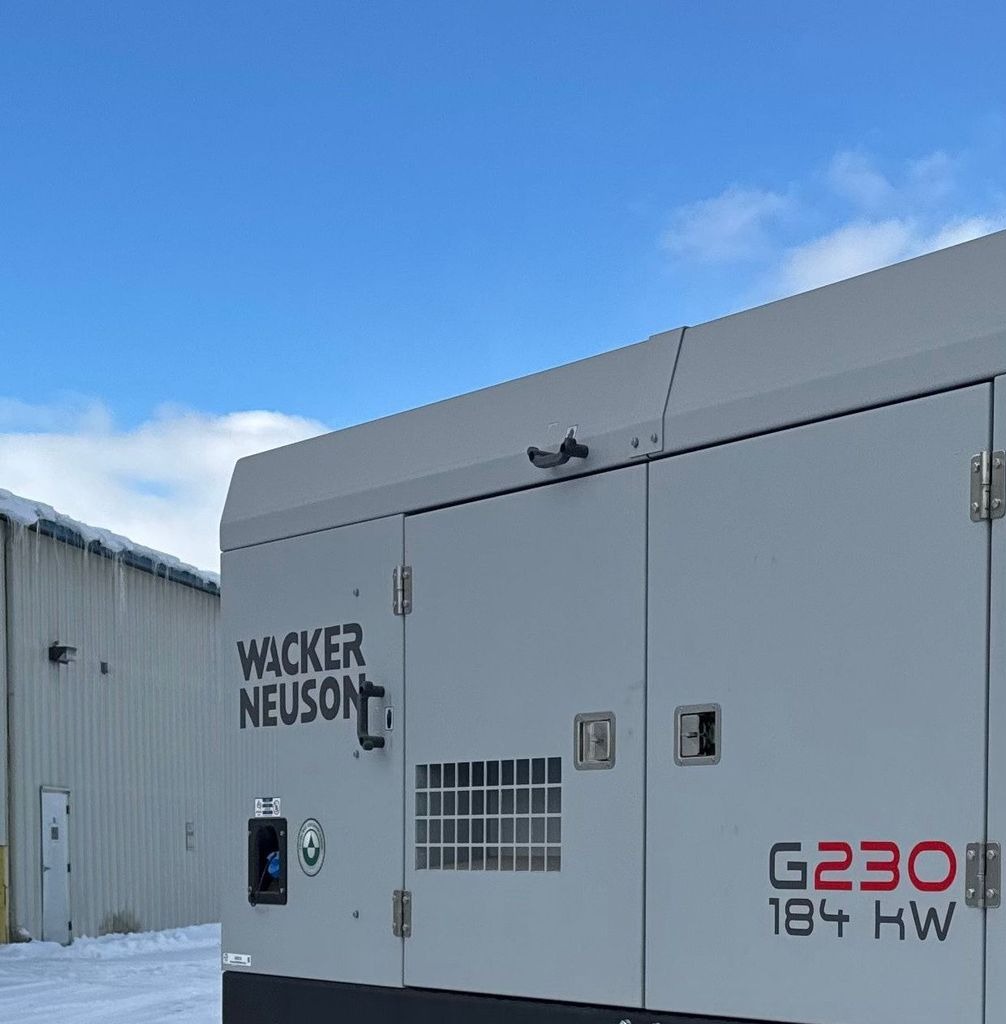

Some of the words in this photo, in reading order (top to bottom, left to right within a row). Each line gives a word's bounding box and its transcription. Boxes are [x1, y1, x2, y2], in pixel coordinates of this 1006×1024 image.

[236, 622, 366, 681] WACKER
[239, 673, 366, 730] NEUSON
[769, 841, 957, 892] G230
[769, 898, 850, 938] 184
